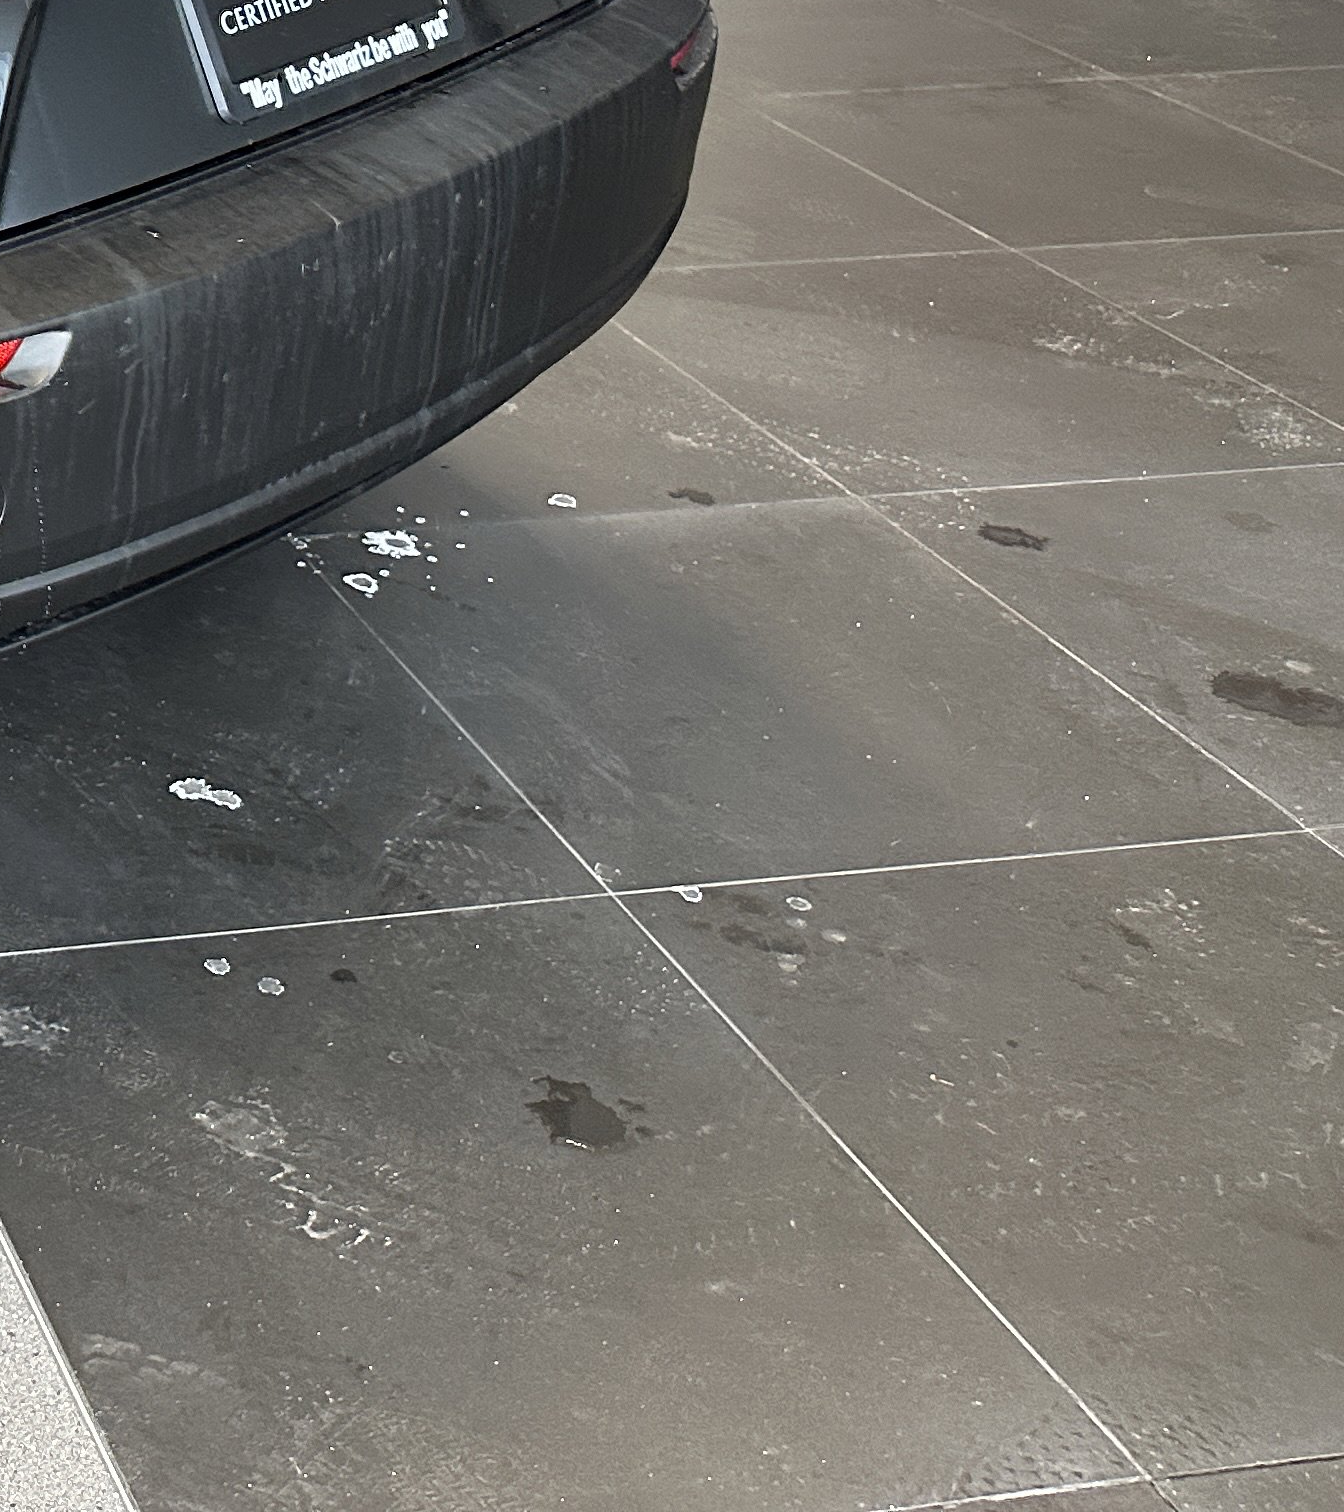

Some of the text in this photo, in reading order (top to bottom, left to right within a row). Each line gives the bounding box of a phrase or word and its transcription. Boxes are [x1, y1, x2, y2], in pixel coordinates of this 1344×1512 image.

[283, 64, 313, 95] the
[308, 38, 375, 86] Schwartz
[367, 35, 392, 64] be
[387, 22, 419, 56] with
